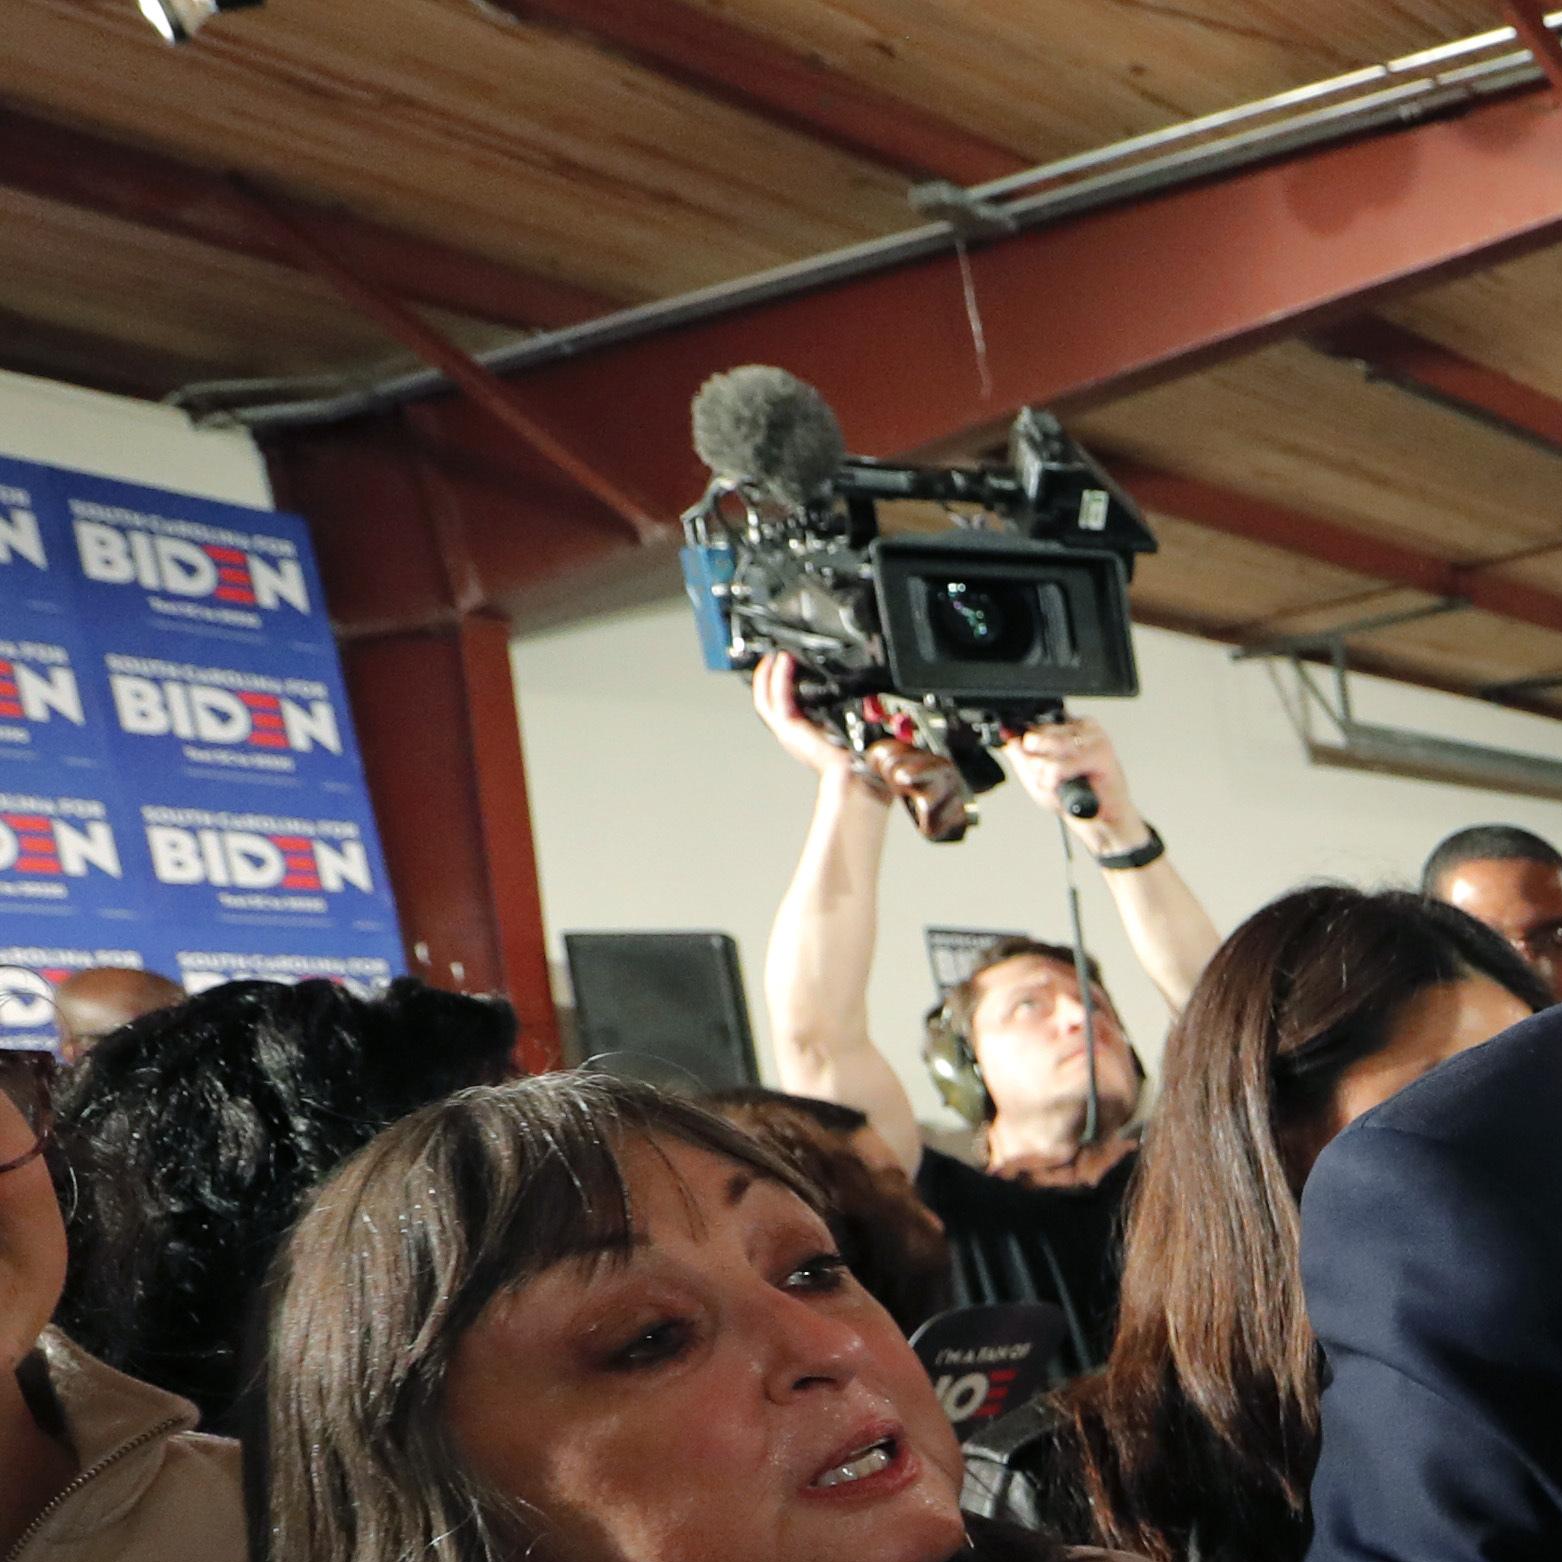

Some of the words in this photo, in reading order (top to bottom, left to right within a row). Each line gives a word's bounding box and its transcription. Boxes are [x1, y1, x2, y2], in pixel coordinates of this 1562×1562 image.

[73, 518, 311, 616] BIDEN
[109, 673, 343, 756] BIDEN
[145, 823, 375, 895] BIDEN
